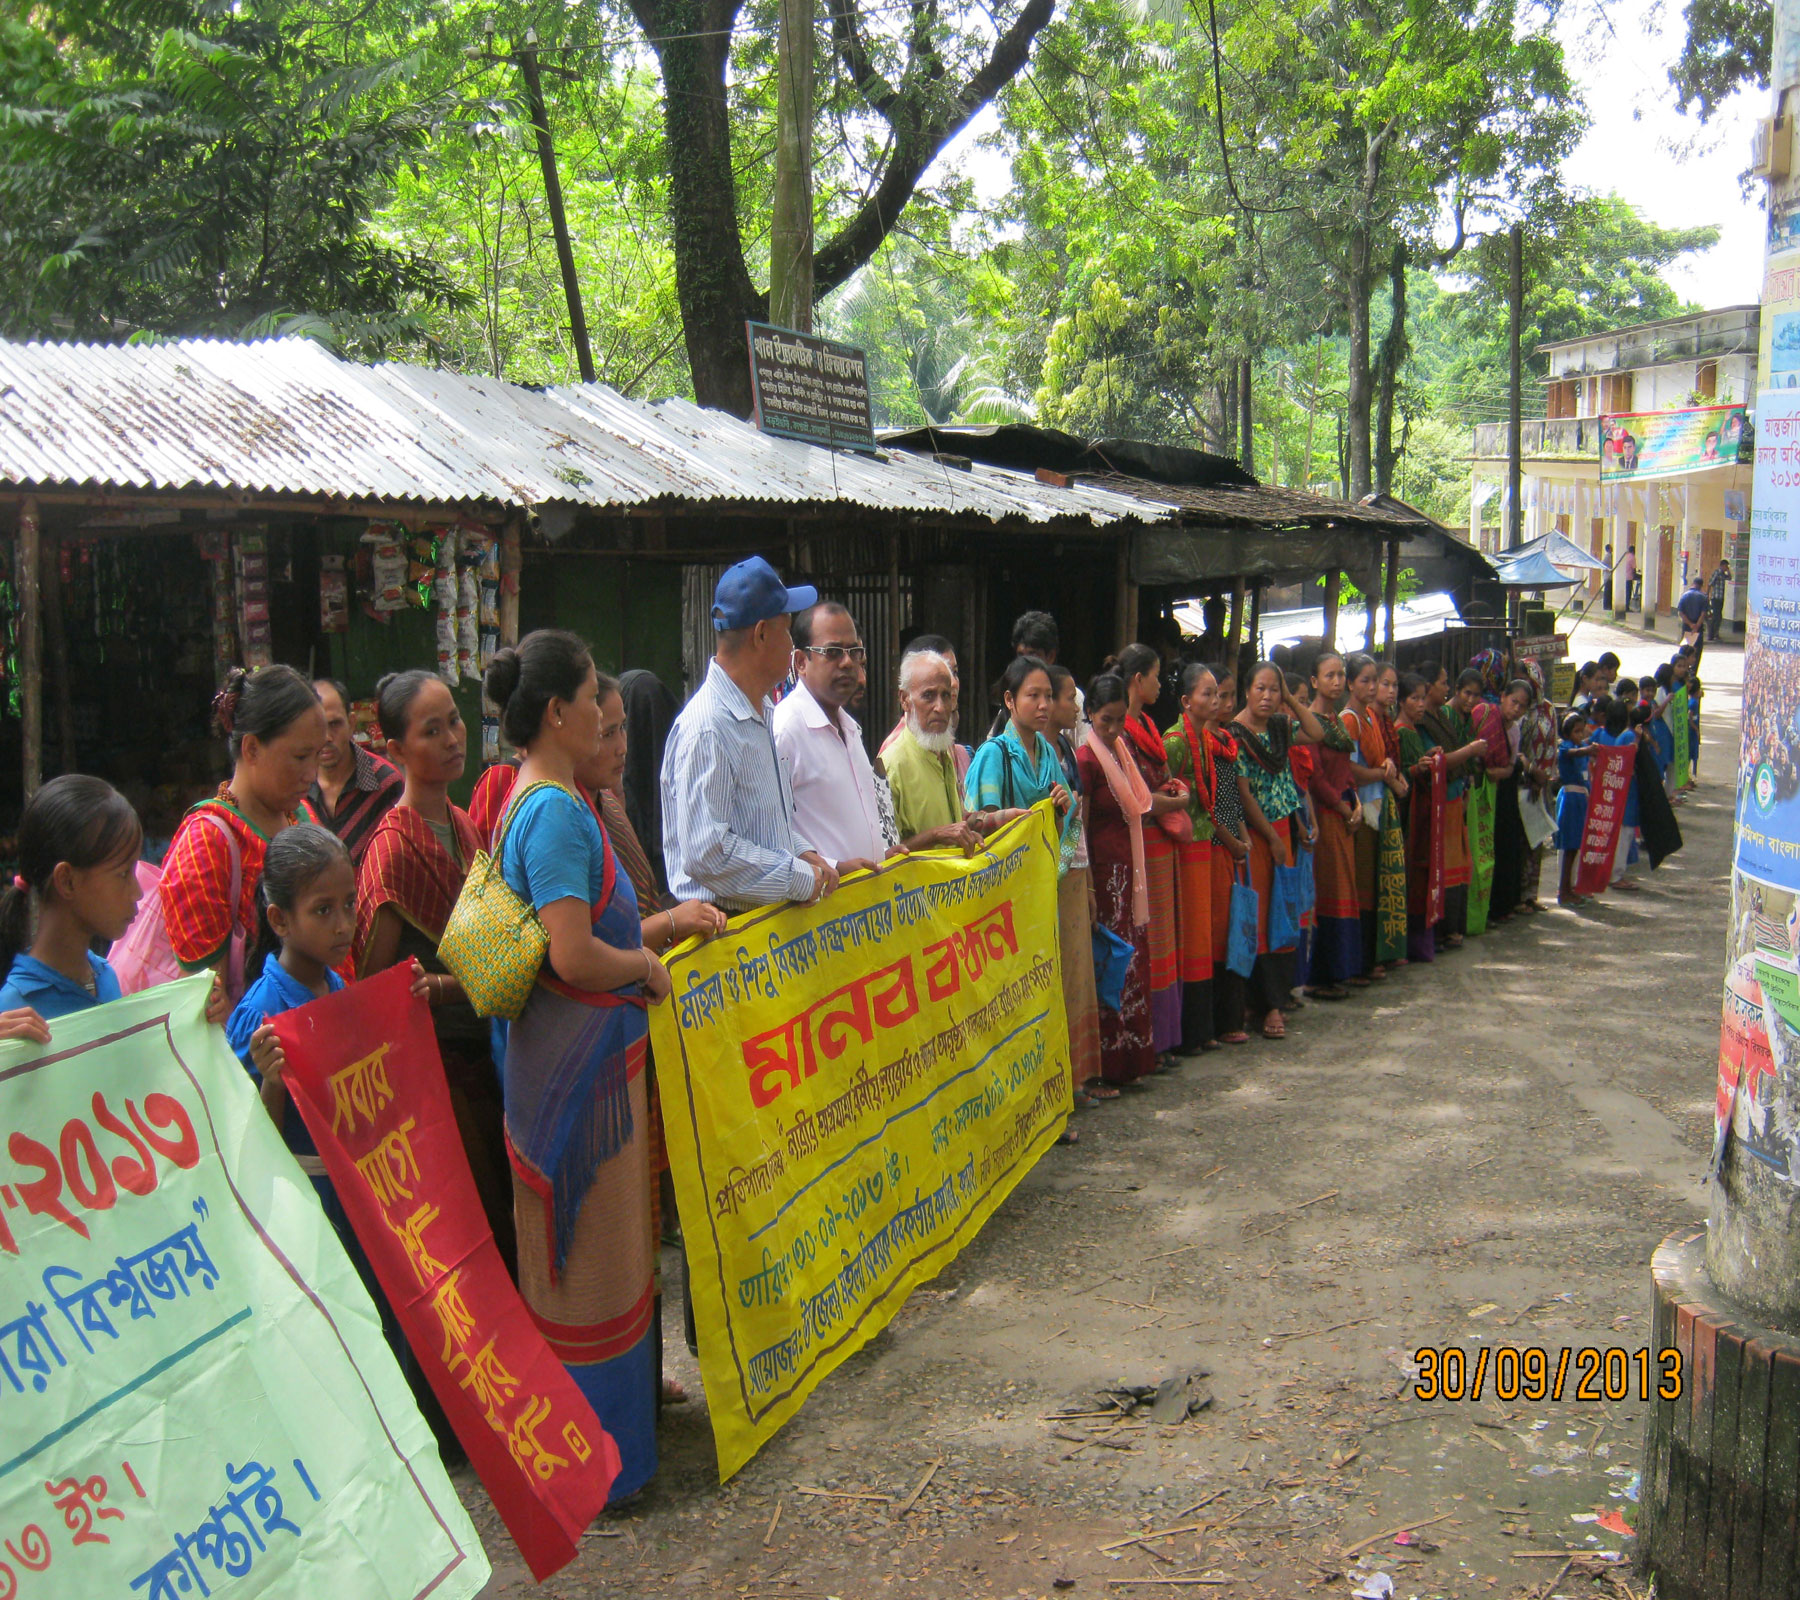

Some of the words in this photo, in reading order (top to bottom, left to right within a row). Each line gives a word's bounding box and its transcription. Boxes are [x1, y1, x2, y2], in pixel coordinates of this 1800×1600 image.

[679, 970, 724, 1030] মহিলা
[725, 968, 739, 1002] ও
[736, 946, 779, 1000] শিশু
[769, 932, 817, 984] বিষয়ক
[742, 953, 920, 1108] মানব
[922, 900, 1019, 1003] বন্ধন
[330, 1042, 394, 1136] সবার
